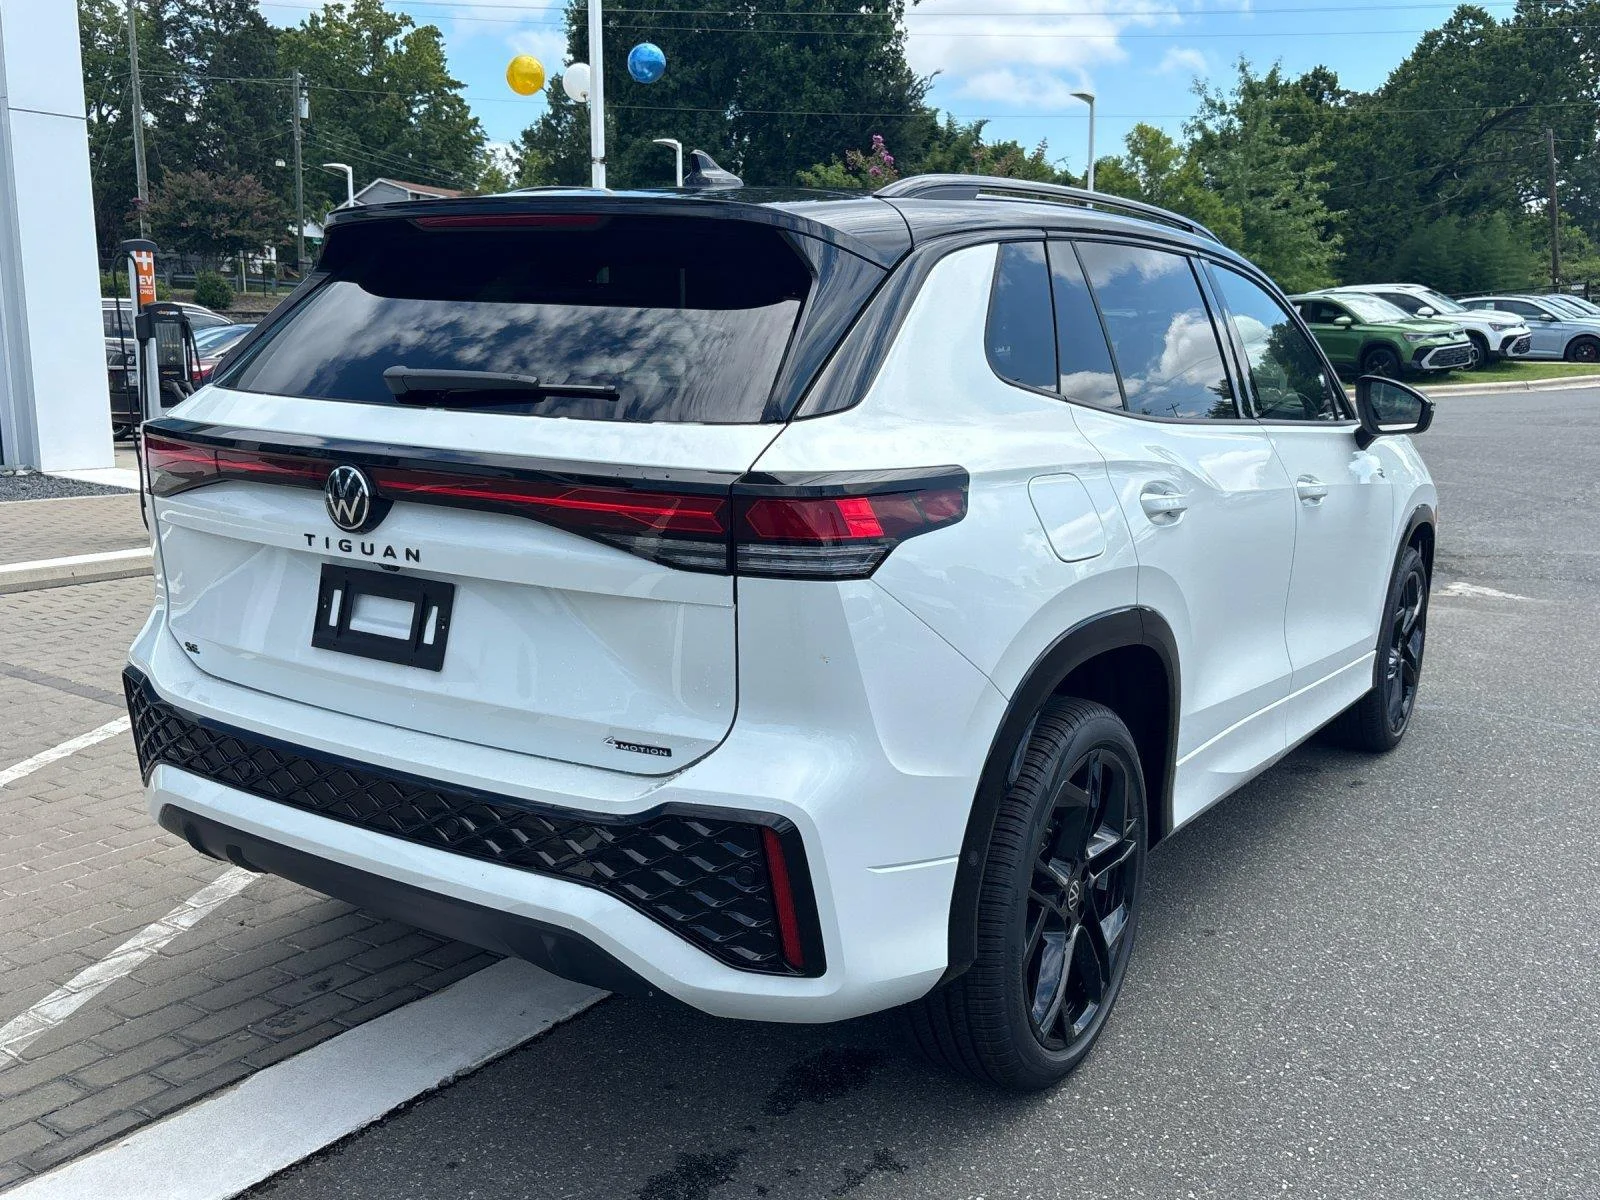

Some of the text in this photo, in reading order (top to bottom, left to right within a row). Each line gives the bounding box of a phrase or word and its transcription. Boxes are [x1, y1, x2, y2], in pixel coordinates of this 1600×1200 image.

[138, 275, 153, 285] EV
[327, 467, 367, 528] VW
[303, 532, 421, 563] TIGUAN
[184, 641, 201, 655] SE
[601, 735, 669, 757] 4MOTION
